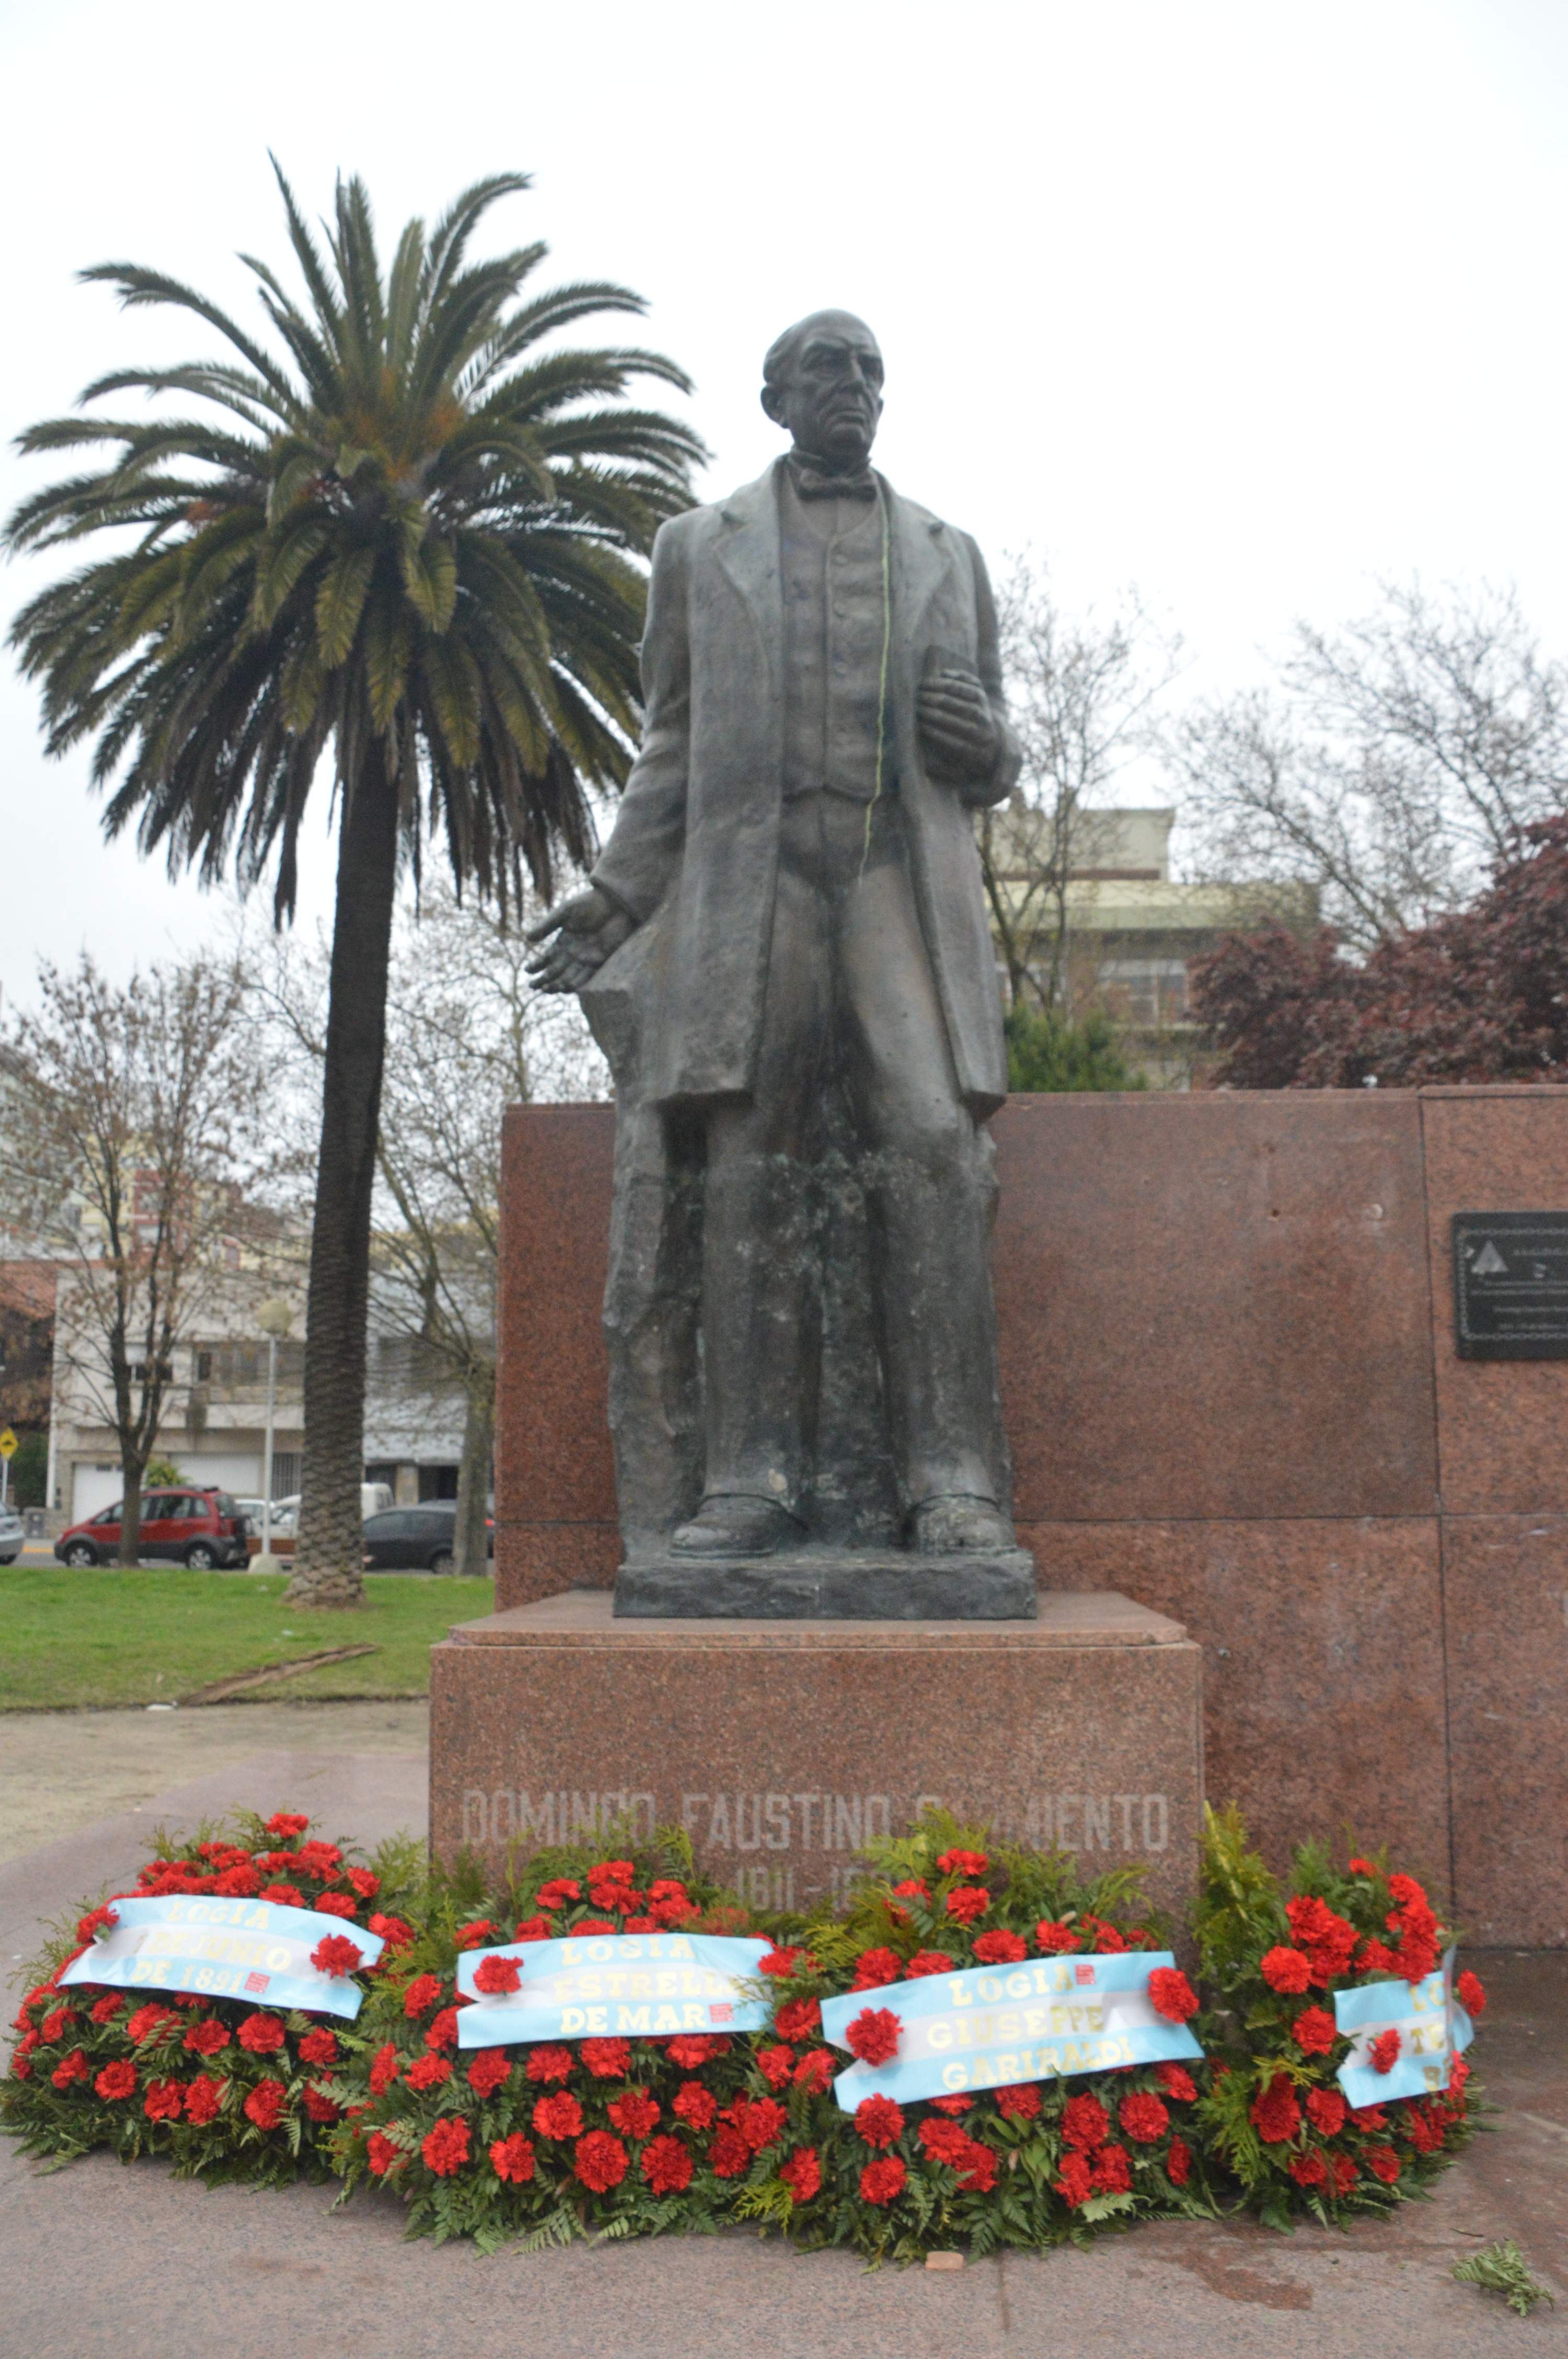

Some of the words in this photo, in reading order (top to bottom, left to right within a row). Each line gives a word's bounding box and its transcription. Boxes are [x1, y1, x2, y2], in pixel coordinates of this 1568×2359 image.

[682, 1792, 891, 1850] FAUSTINO
[736, 1865, 794, 1911] 1811
[167, 1900, 270, 1930] LOGIA
[190, 1933, 292, 1971] JUNIO
[560, 1937, 696, 1966] LOGIA
[131, 1959, 171, 1984] DE
[180, 1965, 246, 1994] 1891
[948, 1964, 1074, 2007] LOGIA
[560, 2006, 608, 2034] DE
[616, 2003, 707, 2032] MAR
[926, 2005, 1105, 2049] GIUSEPPE
[941, 2035, 1135, 2091] GARIBALDI
